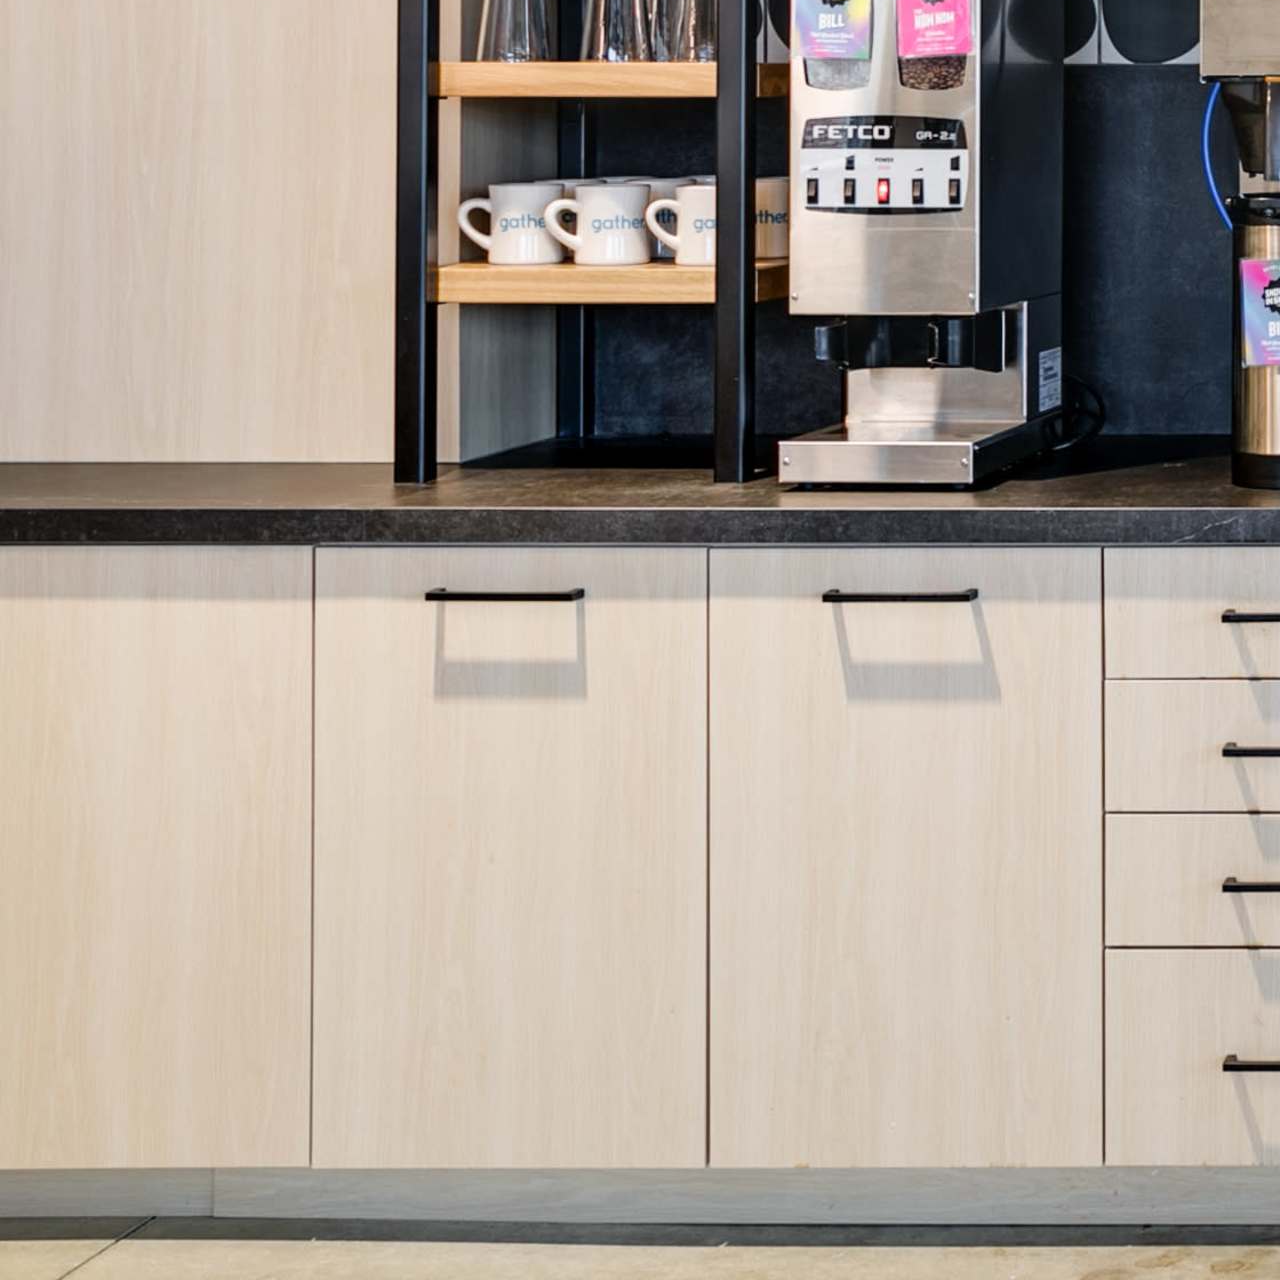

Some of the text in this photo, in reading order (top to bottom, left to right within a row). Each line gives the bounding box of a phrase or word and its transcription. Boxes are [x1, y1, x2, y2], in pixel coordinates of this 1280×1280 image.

[818, 13, 845, 30] BILL
[812, 125, 891, 140] FETCO
[499, 213, 545, 232] gathe
